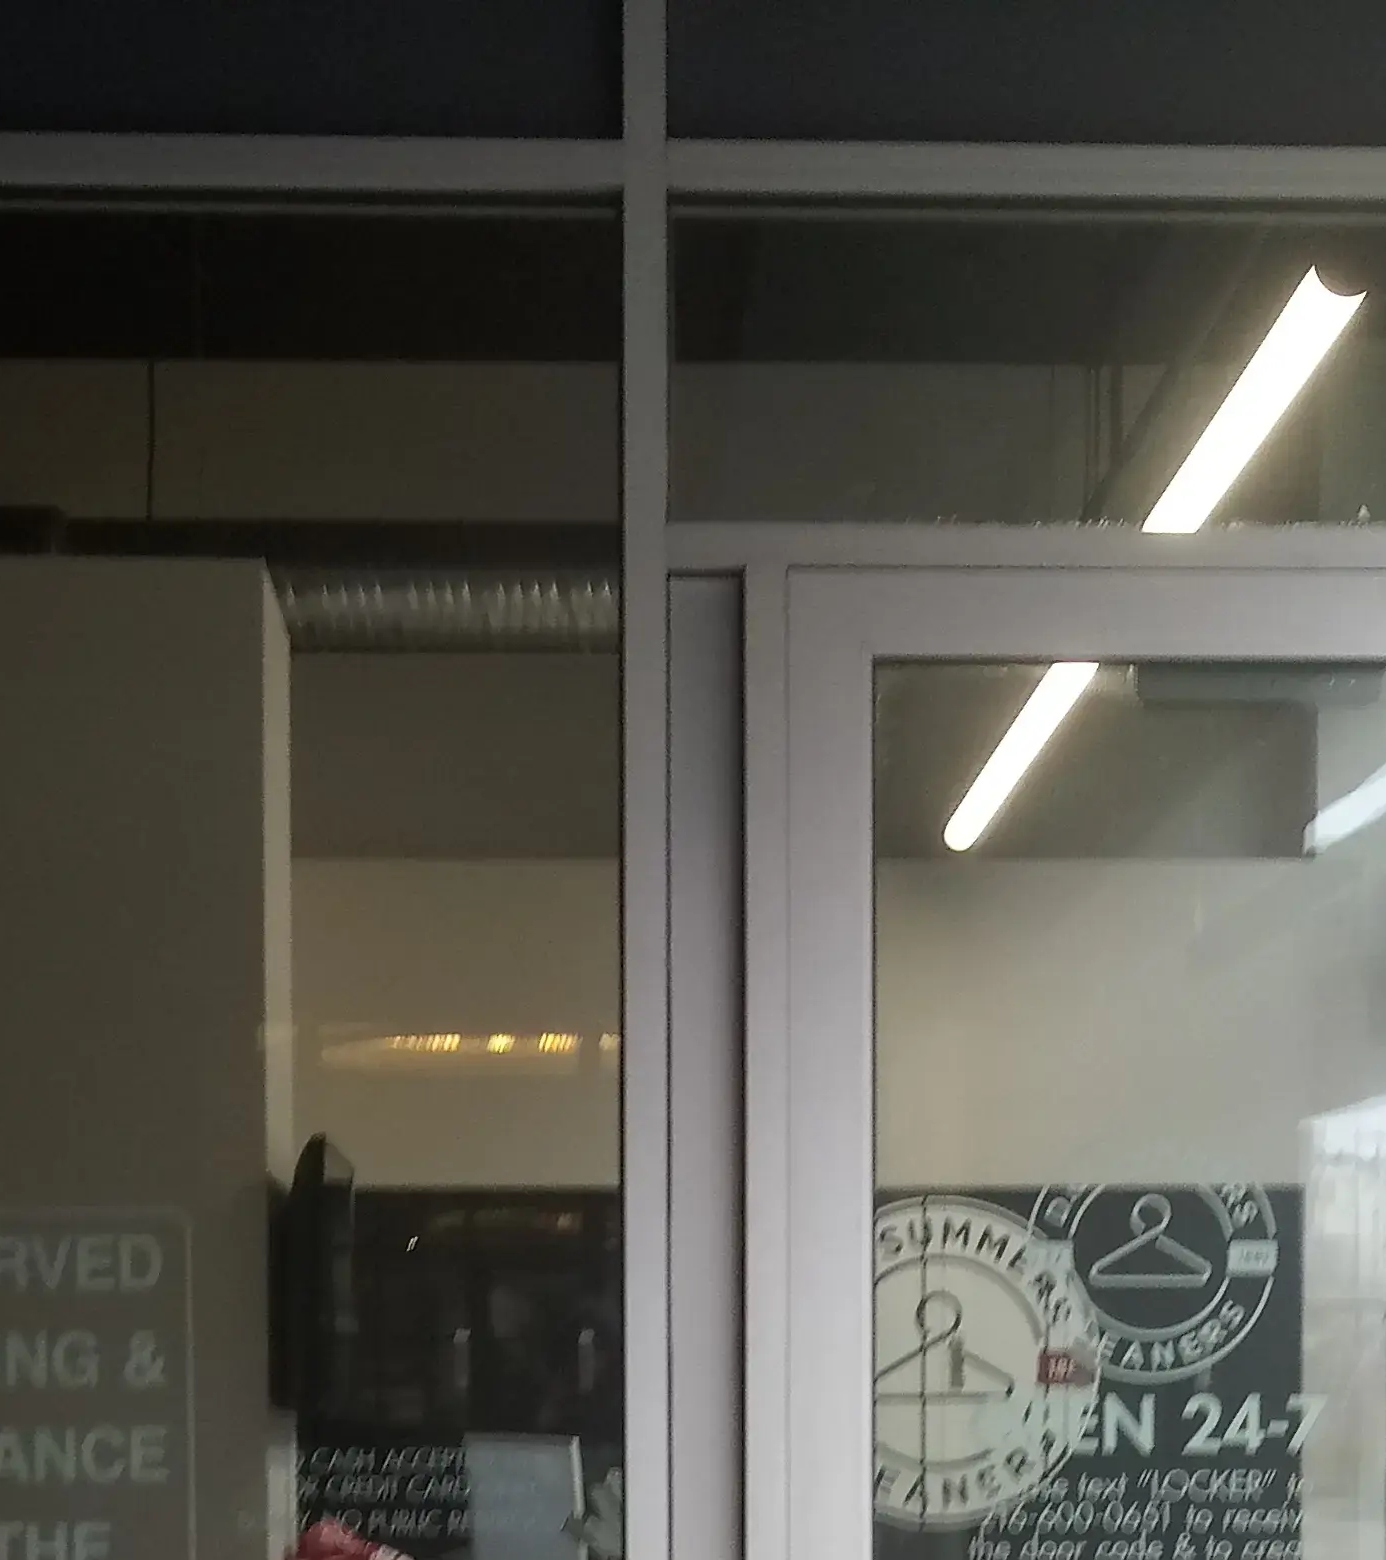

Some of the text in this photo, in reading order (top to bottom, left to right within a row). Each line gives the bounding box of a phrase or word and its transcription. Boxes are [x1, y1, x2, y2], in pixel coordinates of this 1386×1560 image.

[123, 1330, 168, 1390] &
[1181, 1392, 1327, 1457] 24-7
[1077, 1471, 1129, 1503] text
[1185, 1503, 1215, 1536] to
[1222, 1501, 1304, 1536] receiv
